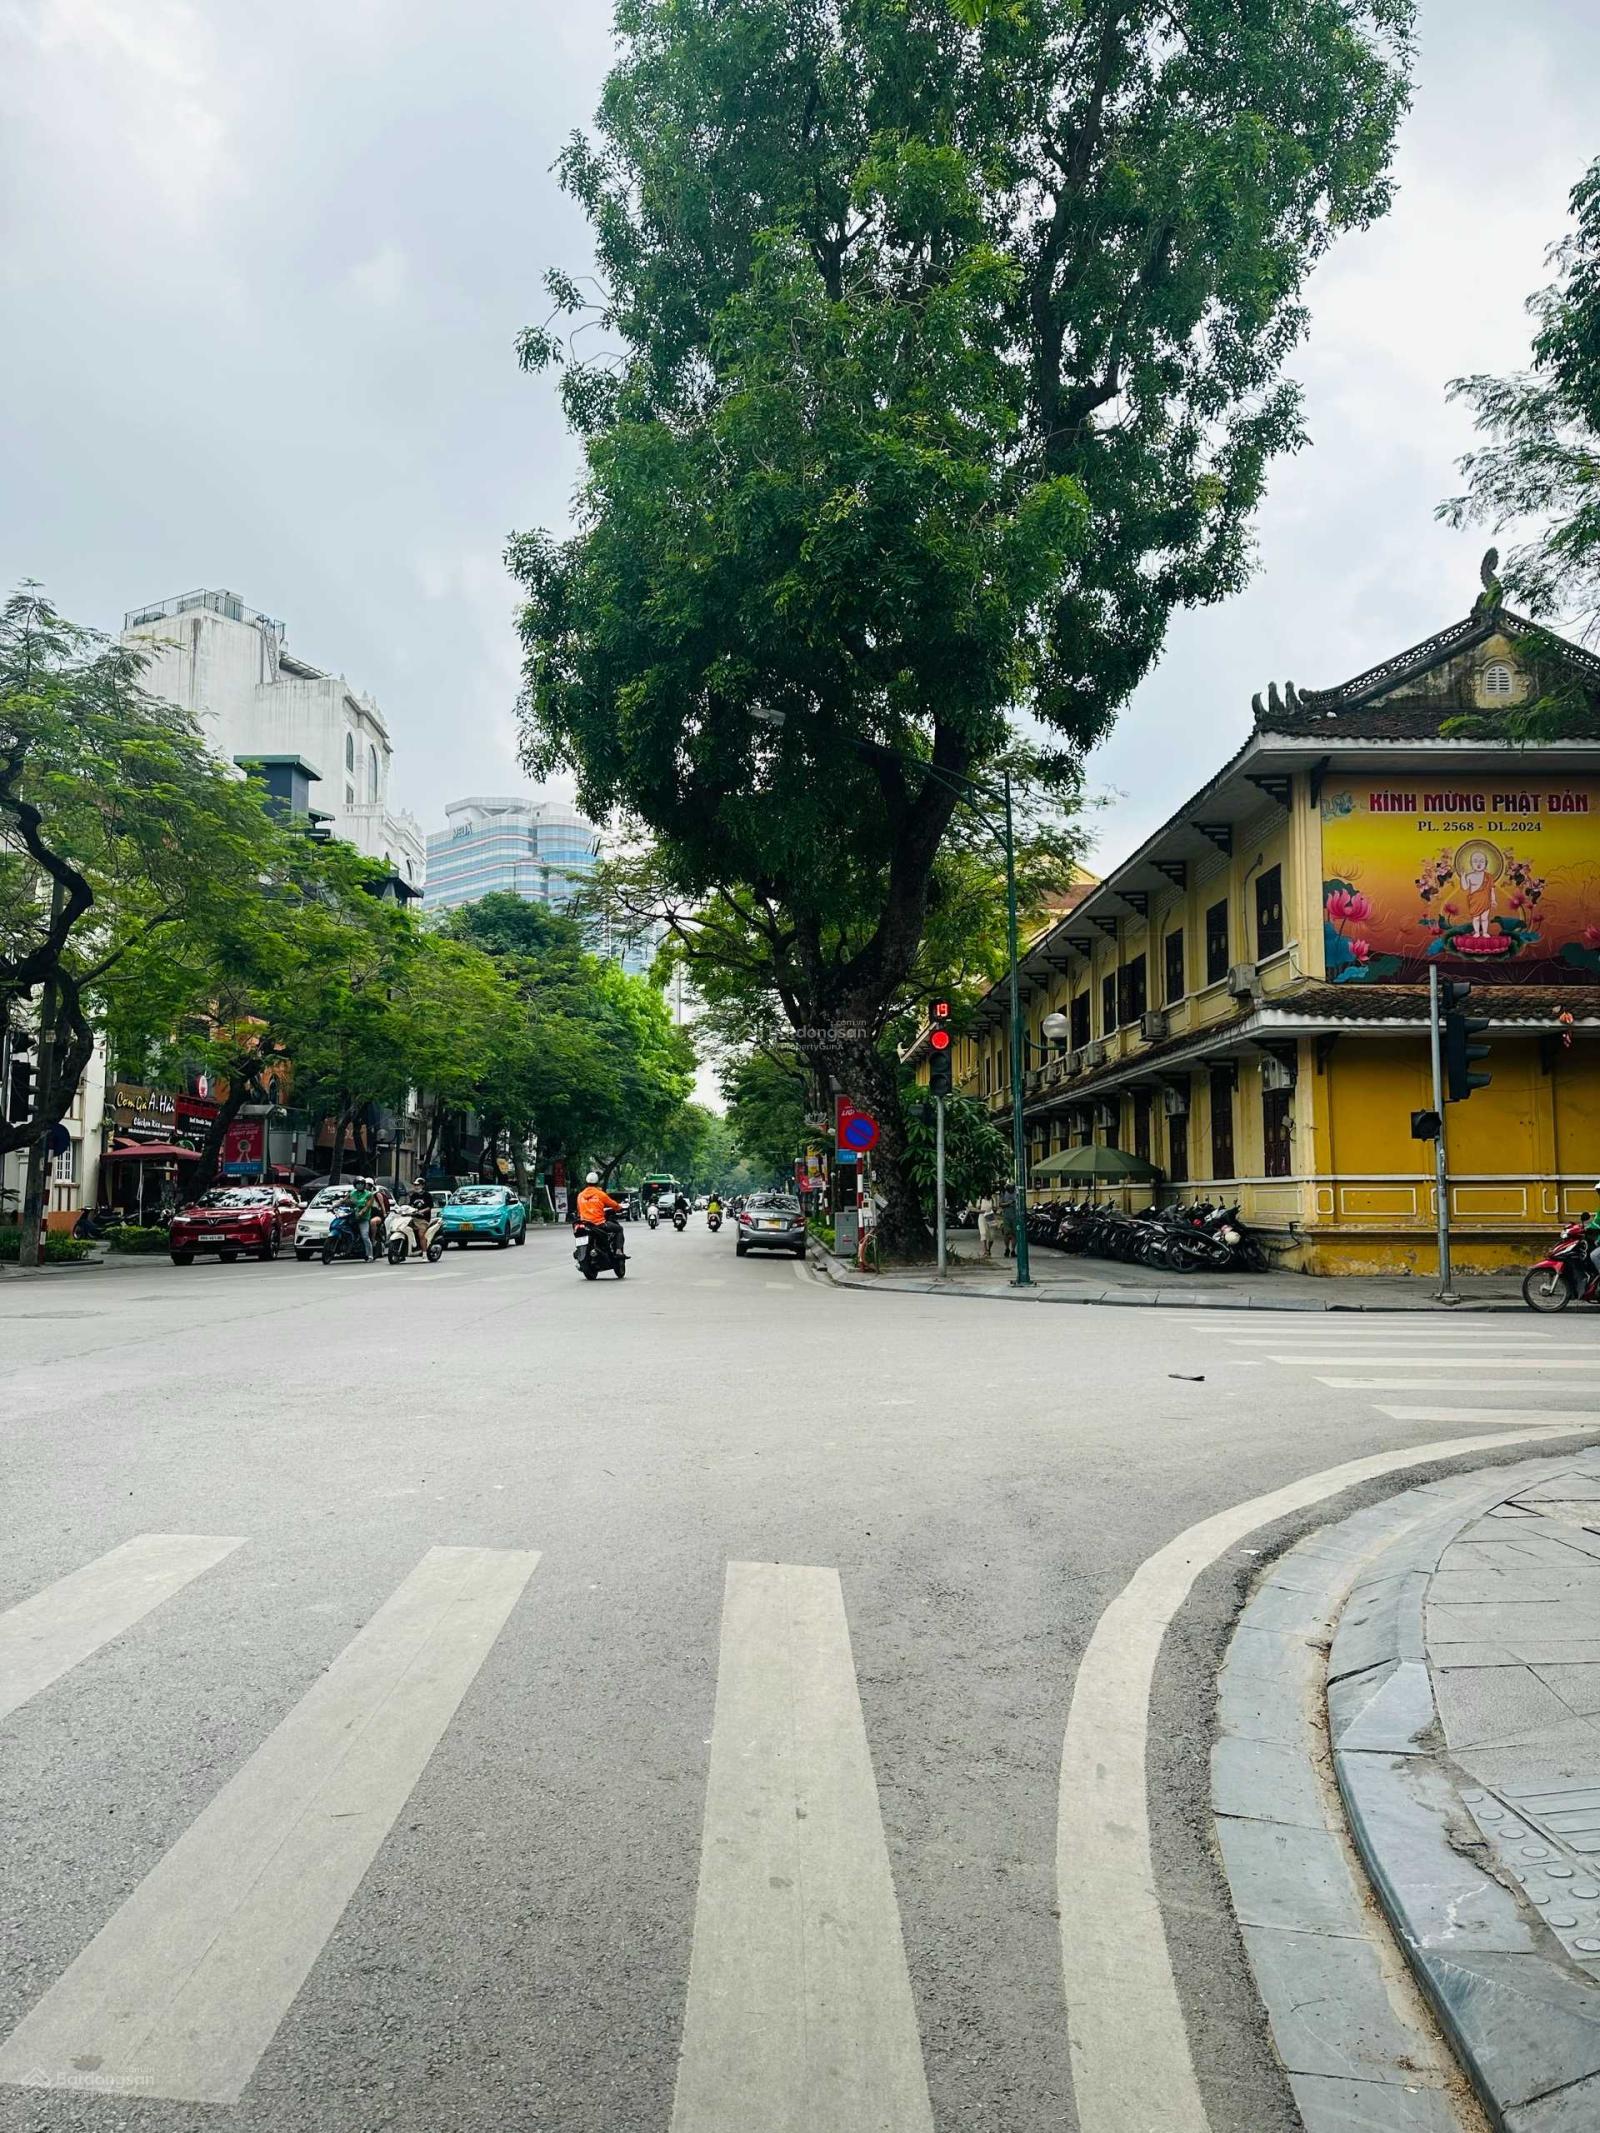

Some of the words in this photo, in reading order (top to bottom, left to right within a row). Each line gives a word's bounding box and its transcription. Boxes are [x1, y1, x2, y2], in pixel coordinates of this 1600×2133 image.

[1369, 790, 1417, 813] KÍNH
[1423, 791, 1486, 813] MỪNG
[1491, 790, 1542, 816] PHẬT
[1547, 789, 1590, 813] ĐẢN
[1418, 821, 1439, 832] PL.
[1443, 821, 1475, 832] 2568
[1487, 821, 1542, 832] DL.2024
[936, 1003, 948, 1017] 19
